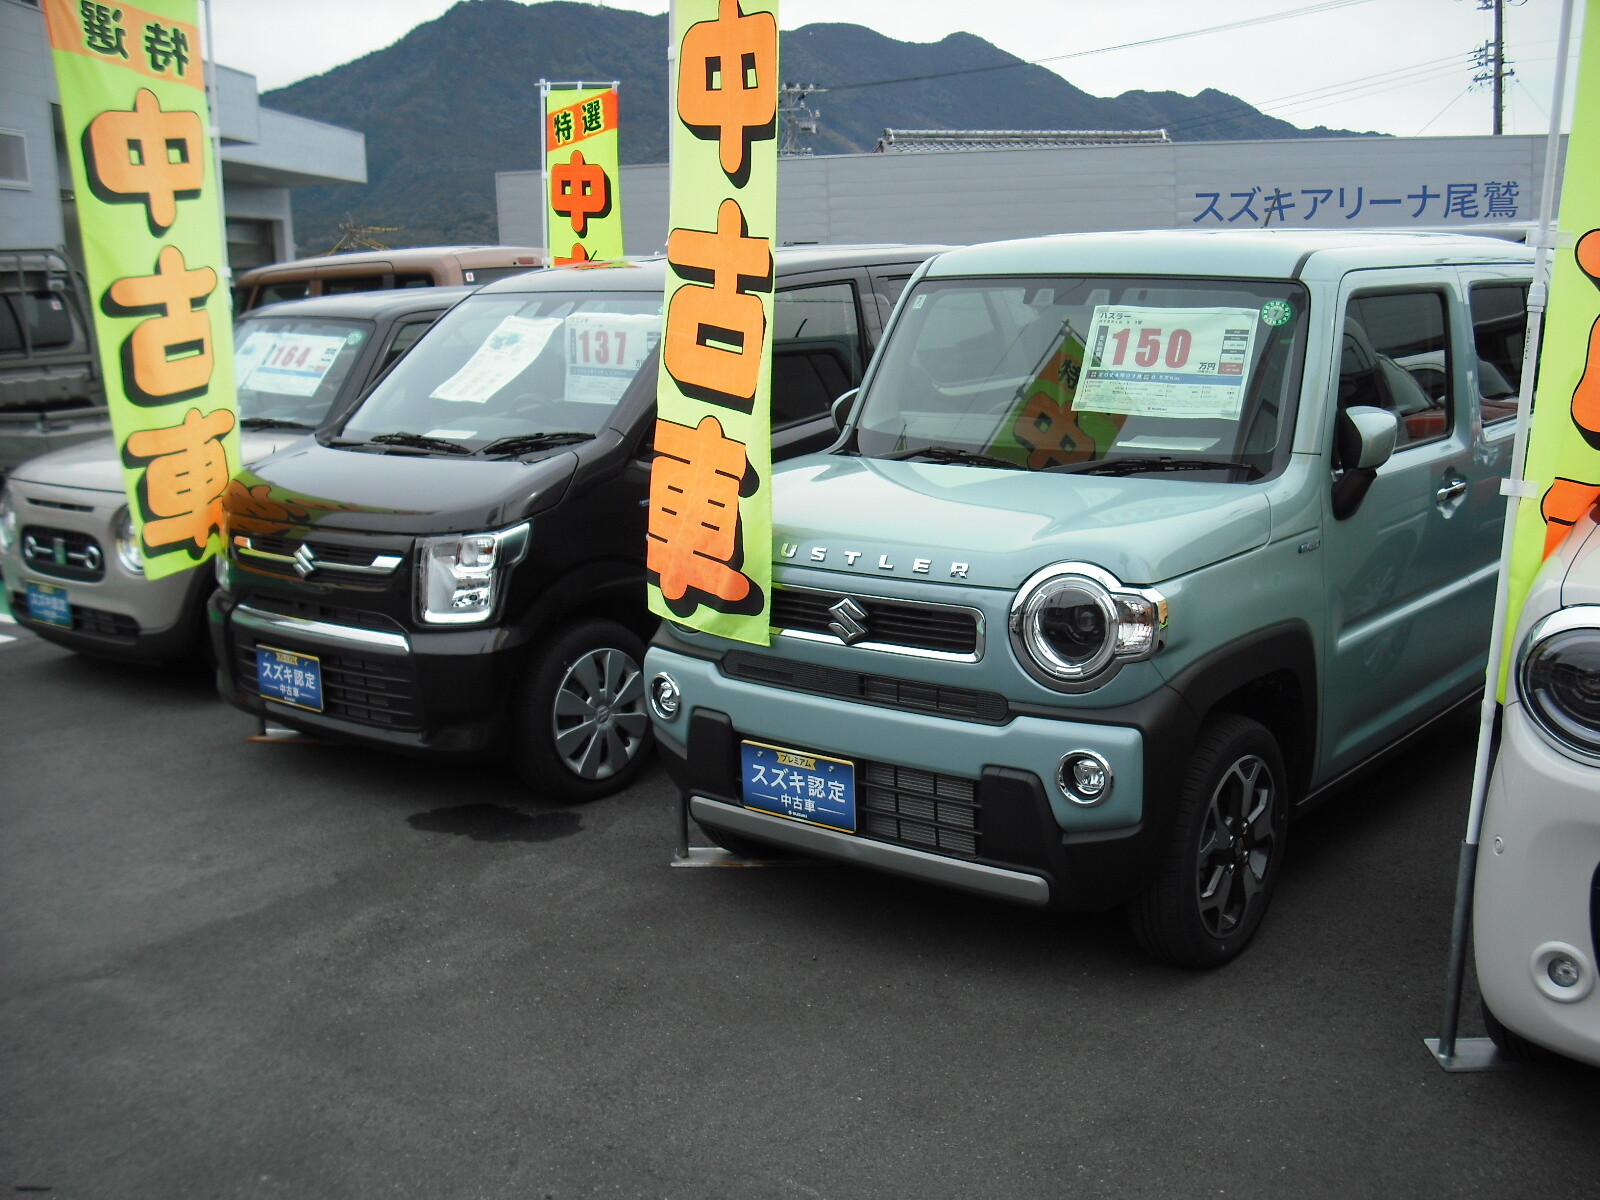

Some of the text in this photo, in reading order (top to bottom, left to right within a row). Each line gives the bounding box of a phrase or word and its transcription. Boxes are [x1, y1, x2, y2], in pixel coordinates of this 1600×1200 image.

[554, 100, 601, 143] 特選
[1192, 181, 1519, 223] スズキアリーナ尾鷲
[647, 0, 776, 618] 中古車
[1099, 312, 1131, 320] ハスラー
[271, 346, 312, 368] 164
[579, 330, 627, 365] 137
[1112, 328, 1193, 369] 150
[1199, 362, 1216, 371] 万円
[780, 542, 970, 579] USTLER
[262, 662, 316, 690] スズキ認定
[779, 754, 812, 767] プレミアム
[751, 763, 846, 804] スズキ認定
[780, 793, 816, 813] 中古車
